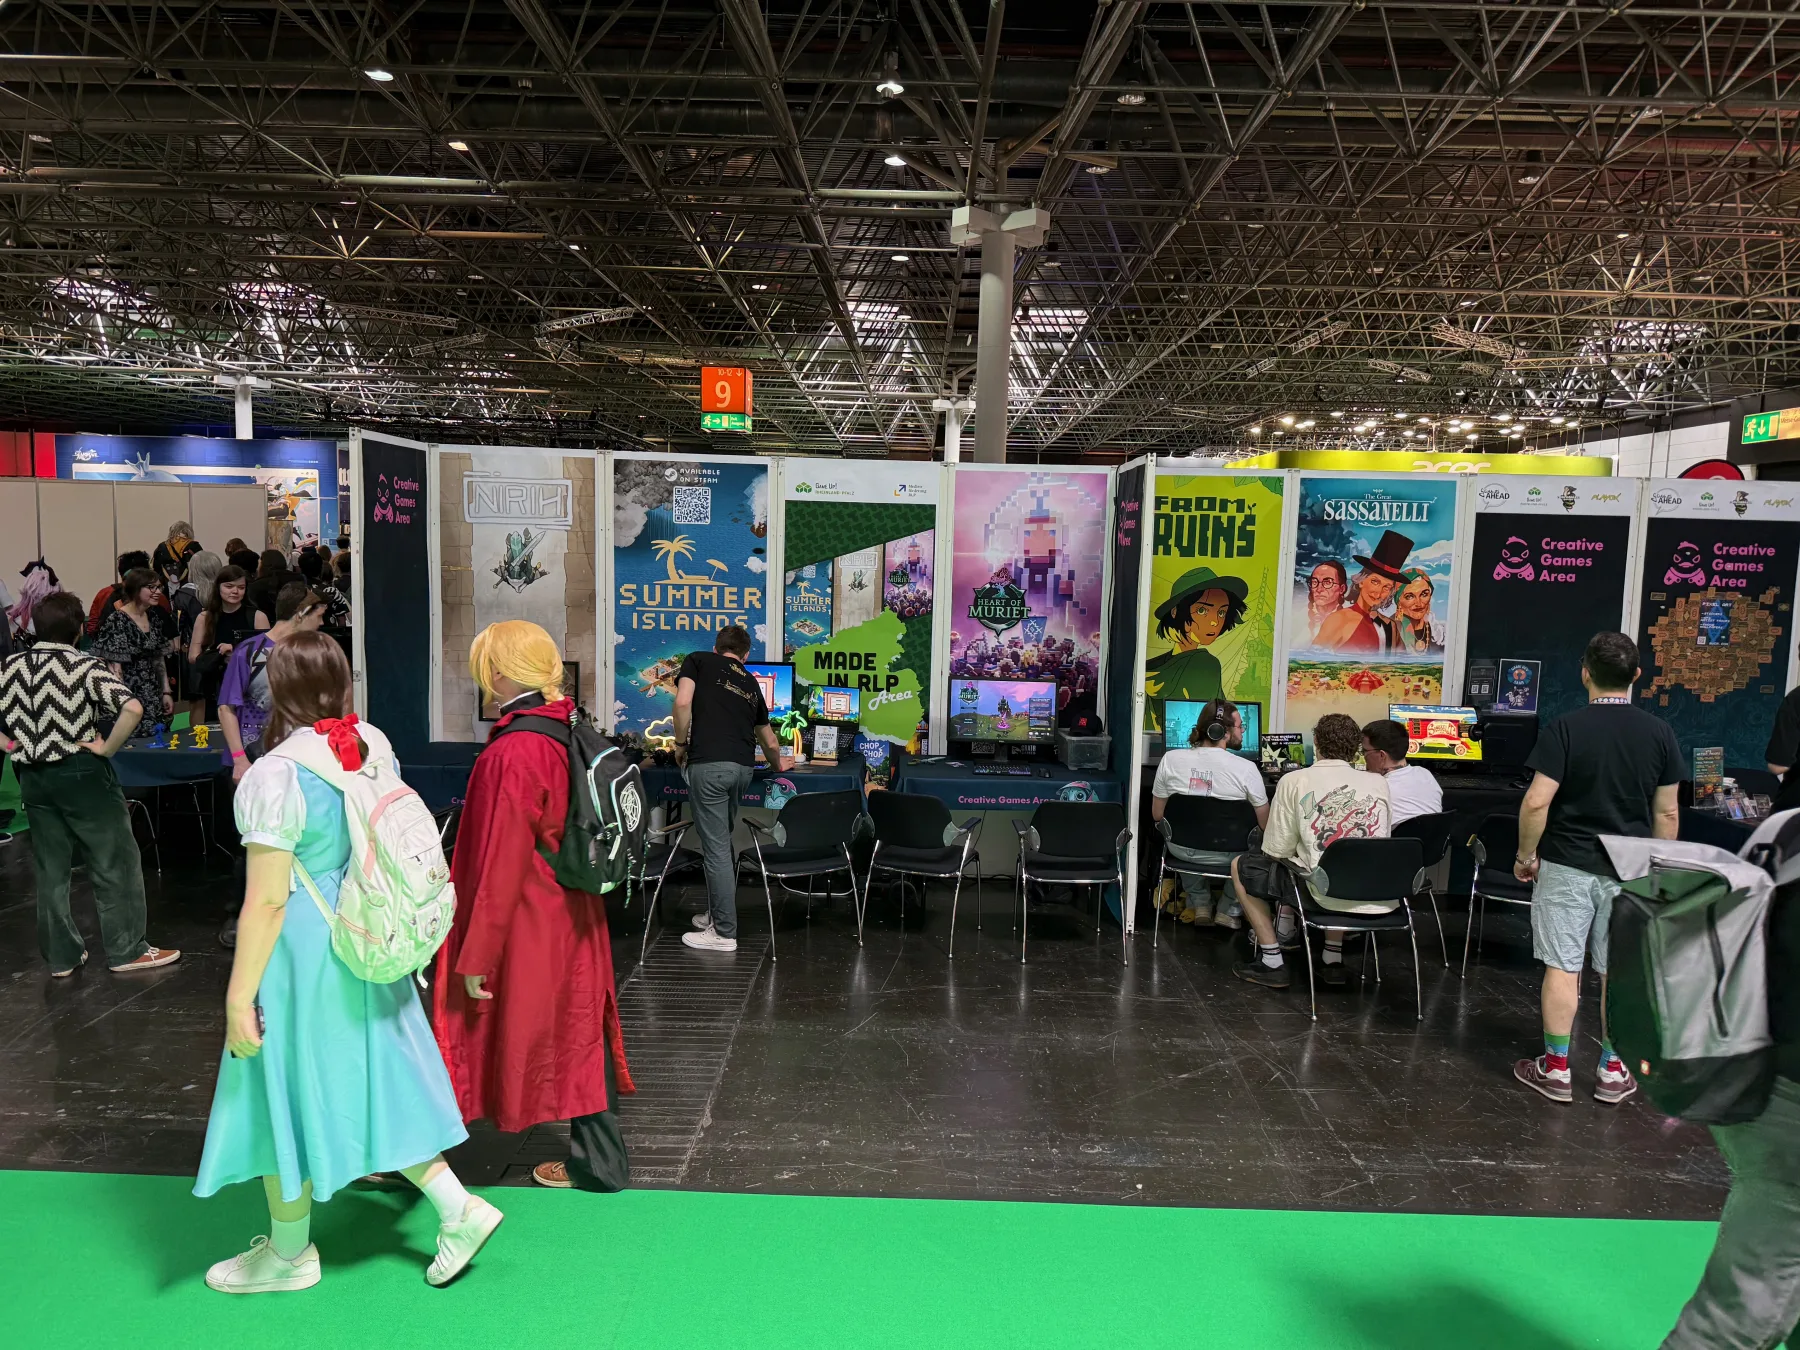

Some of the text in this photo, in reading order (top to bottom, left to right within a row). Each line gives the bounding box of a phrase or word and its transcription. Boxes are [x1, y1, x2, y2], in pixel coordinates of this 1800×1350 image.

[718, 368, 732, 376] 10-12
[715, 381, 731, 408] 9
[394, 476, 419, 492] Creative
[394, 495, 416, 508] Games
[1154, 496, 1246, 513] FROM
[395, 511, 410, 524] Area
[1153, 513, 1256, 558] RUINS
[1542, 538, 1604, 551] Creative
[1713, 543, 1775, 556] Creative
[1540, 554, 1592, 567] Games
[1712, 559, 1763, 572] Games
[1539, 570, 1576, 582] Area
[1710, 575, 1747, 587] Area
[620, 584, 761, 609] SUMMER
[785, 596, 831, 605] SUMMER
[968, 606, 1031, 619] MURIET
[632, 612, 748, 631] ISLANDS
[814, 651, 876, 671] MADE
[827, 673, 899, 693] IN RLP
[868, 689, 913, 711] Area
[958, 796, 996, 804] Creative
